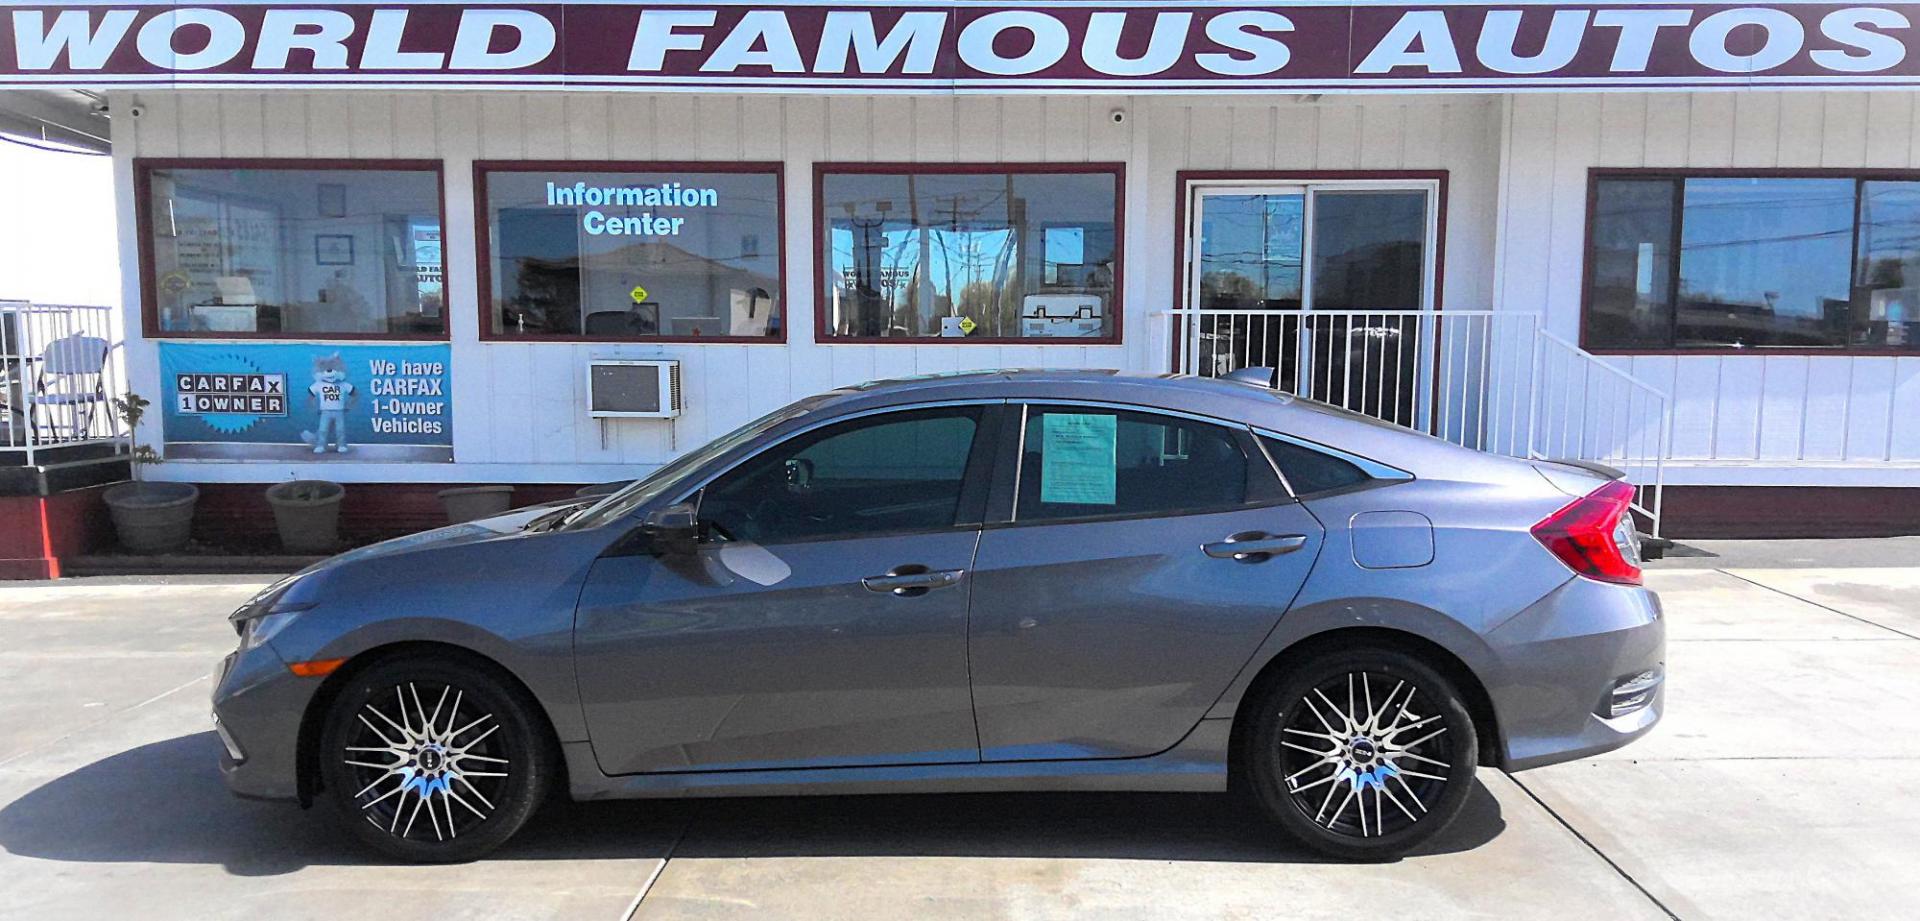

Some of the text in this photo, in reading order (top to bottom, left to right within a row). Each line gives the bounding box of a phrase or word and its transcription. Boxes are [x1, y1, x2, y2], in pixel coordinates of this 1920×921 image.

[11, 7, 1911, 76] WORLD FAMOUS AUTOS
[547, 182, 717, 206] Information
[583, 211, 684, 235] Center
[370, 360, 443, 375] We have
[179, 376, 283, 393] CARFAX
[322, 386, 341, 394] CAR
[370, 379, 443, 396] CARFAX
[324, 394, 340, 402] FOX
[372, 399, 443, 415] 1-Owner
[371, 418, 442, 434] Vehicles
